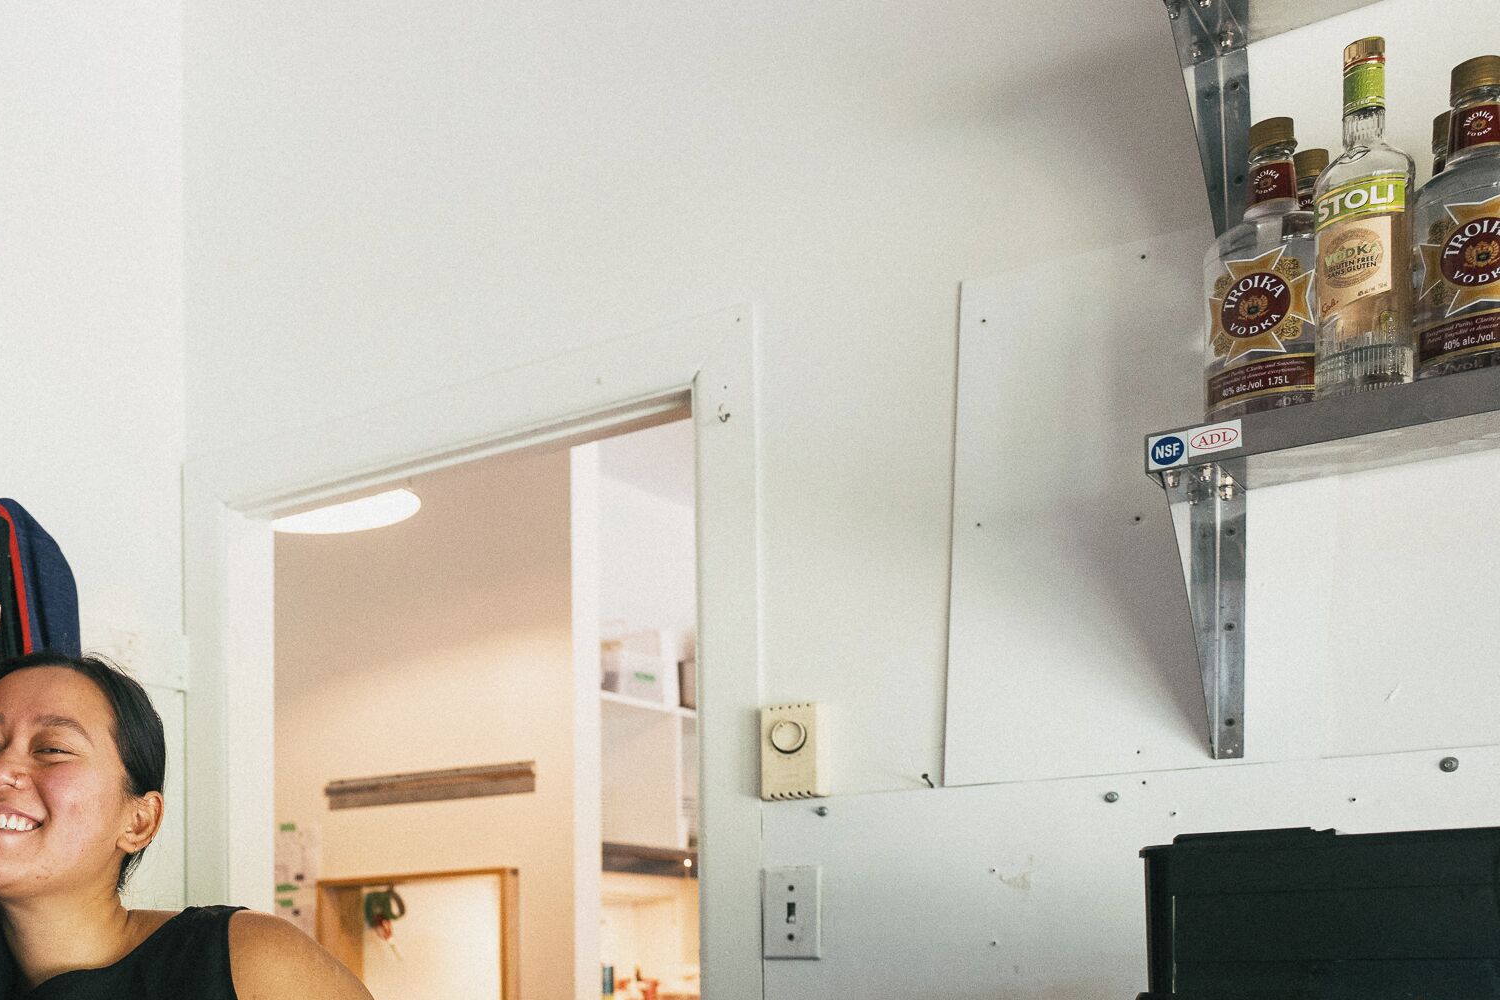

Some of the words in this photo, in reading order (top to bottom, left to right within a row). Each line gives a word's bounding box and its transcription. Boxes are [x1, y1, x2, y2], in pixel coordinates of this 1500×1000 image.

[1463, 111, 1494, 128] TROIKA
[1467, 126, 1493, 137] VODKA
[1253, 169, 1280, 185] TROIKA
[1318, 183, 1395, 223] STOLI
[1324, 241, 1380, 267] VODKA
[1327, 268, 1345, 280] SANS
[1346, 261, 1377, 276] GLUTEN
[1328, 259, 1355, 273] GLUTEN
[1223, 275, 1286, 312] TROIKA
[1230, 313, 1282, 335] VODKA
[1443, 338, 1460, 350] 40%
[1462, 331, 1497, 346] alc./vol.
[1235, 378, 1264, 393] alc./vol.
[1268, 375, 1284, 386] 1.75
[1284, 374, 1290, 384] L
[1197, 431, 1232, 448] ADL
[1155, 442, 1180, 460] NSF
